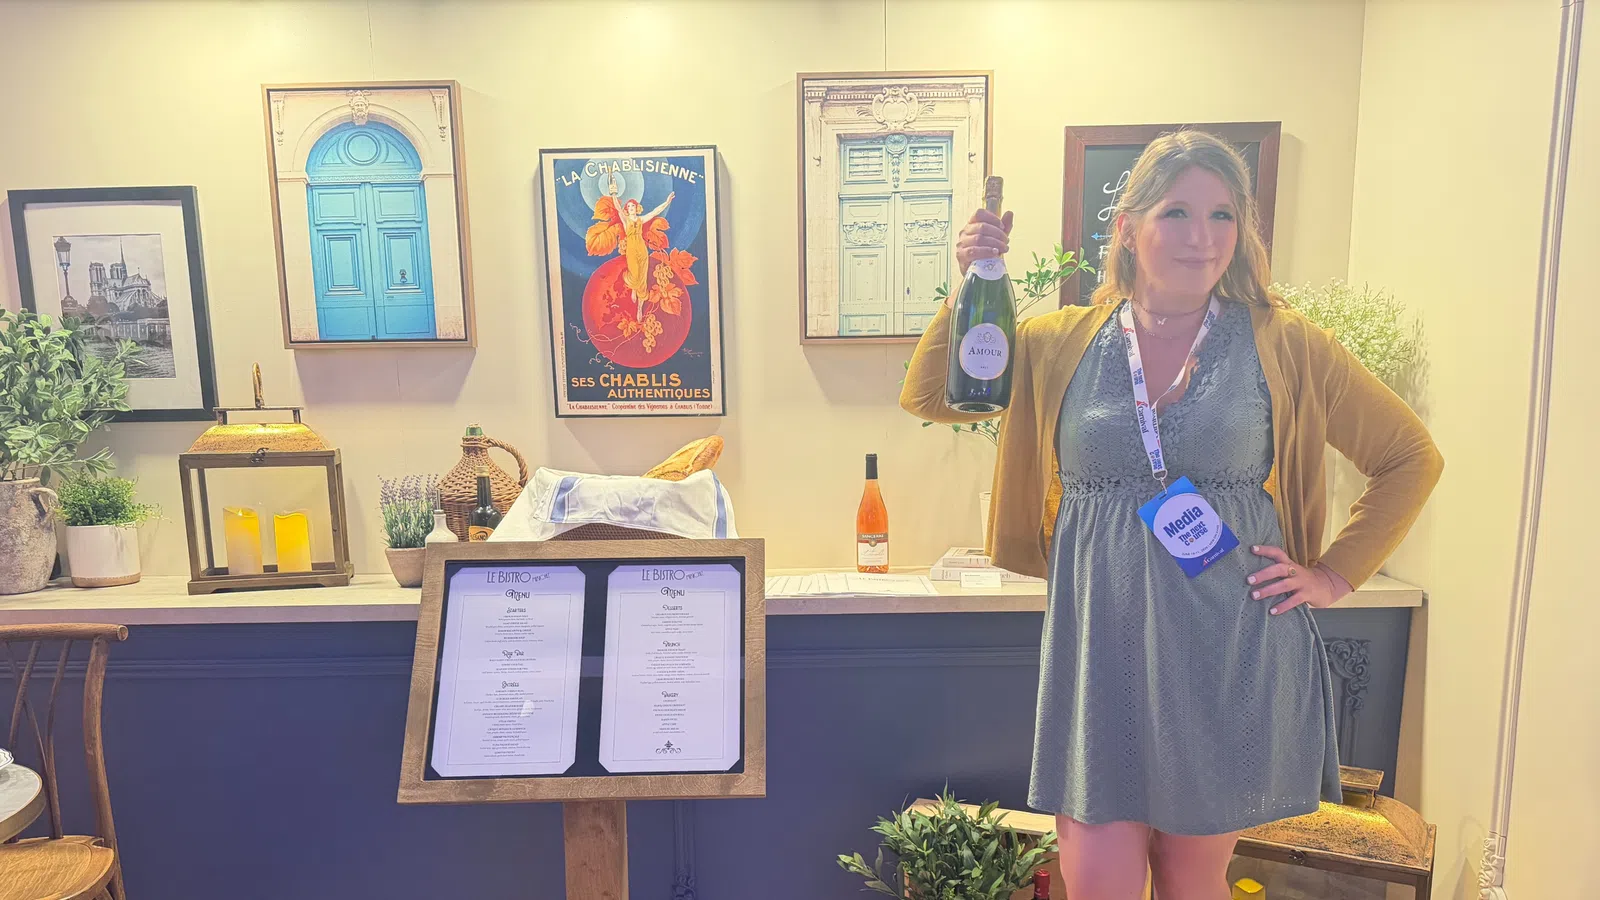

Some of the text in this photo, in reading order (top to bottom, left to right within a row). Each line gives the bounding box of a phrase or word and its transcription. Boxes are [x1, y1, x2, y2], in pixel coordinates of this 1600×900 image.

[967, 346, 1002, 357] AMOUR
[571, 373, 682, 387] SES CHABLIS
[607, 388, 711, 400] AUTHENTIQUES
[1137, 406, 1149, 434] Carnival
[1162, 505, 1204, 538] Media
[1178, 531, 1191, 543] The
[1190, 520, 1206, 536] next
[486, 571, 496, 583] LE
[498, 570, 532, 583] BISTRO
[641, 568, 651, 581] LE
[653, 568, 685, 581] BISTRO
